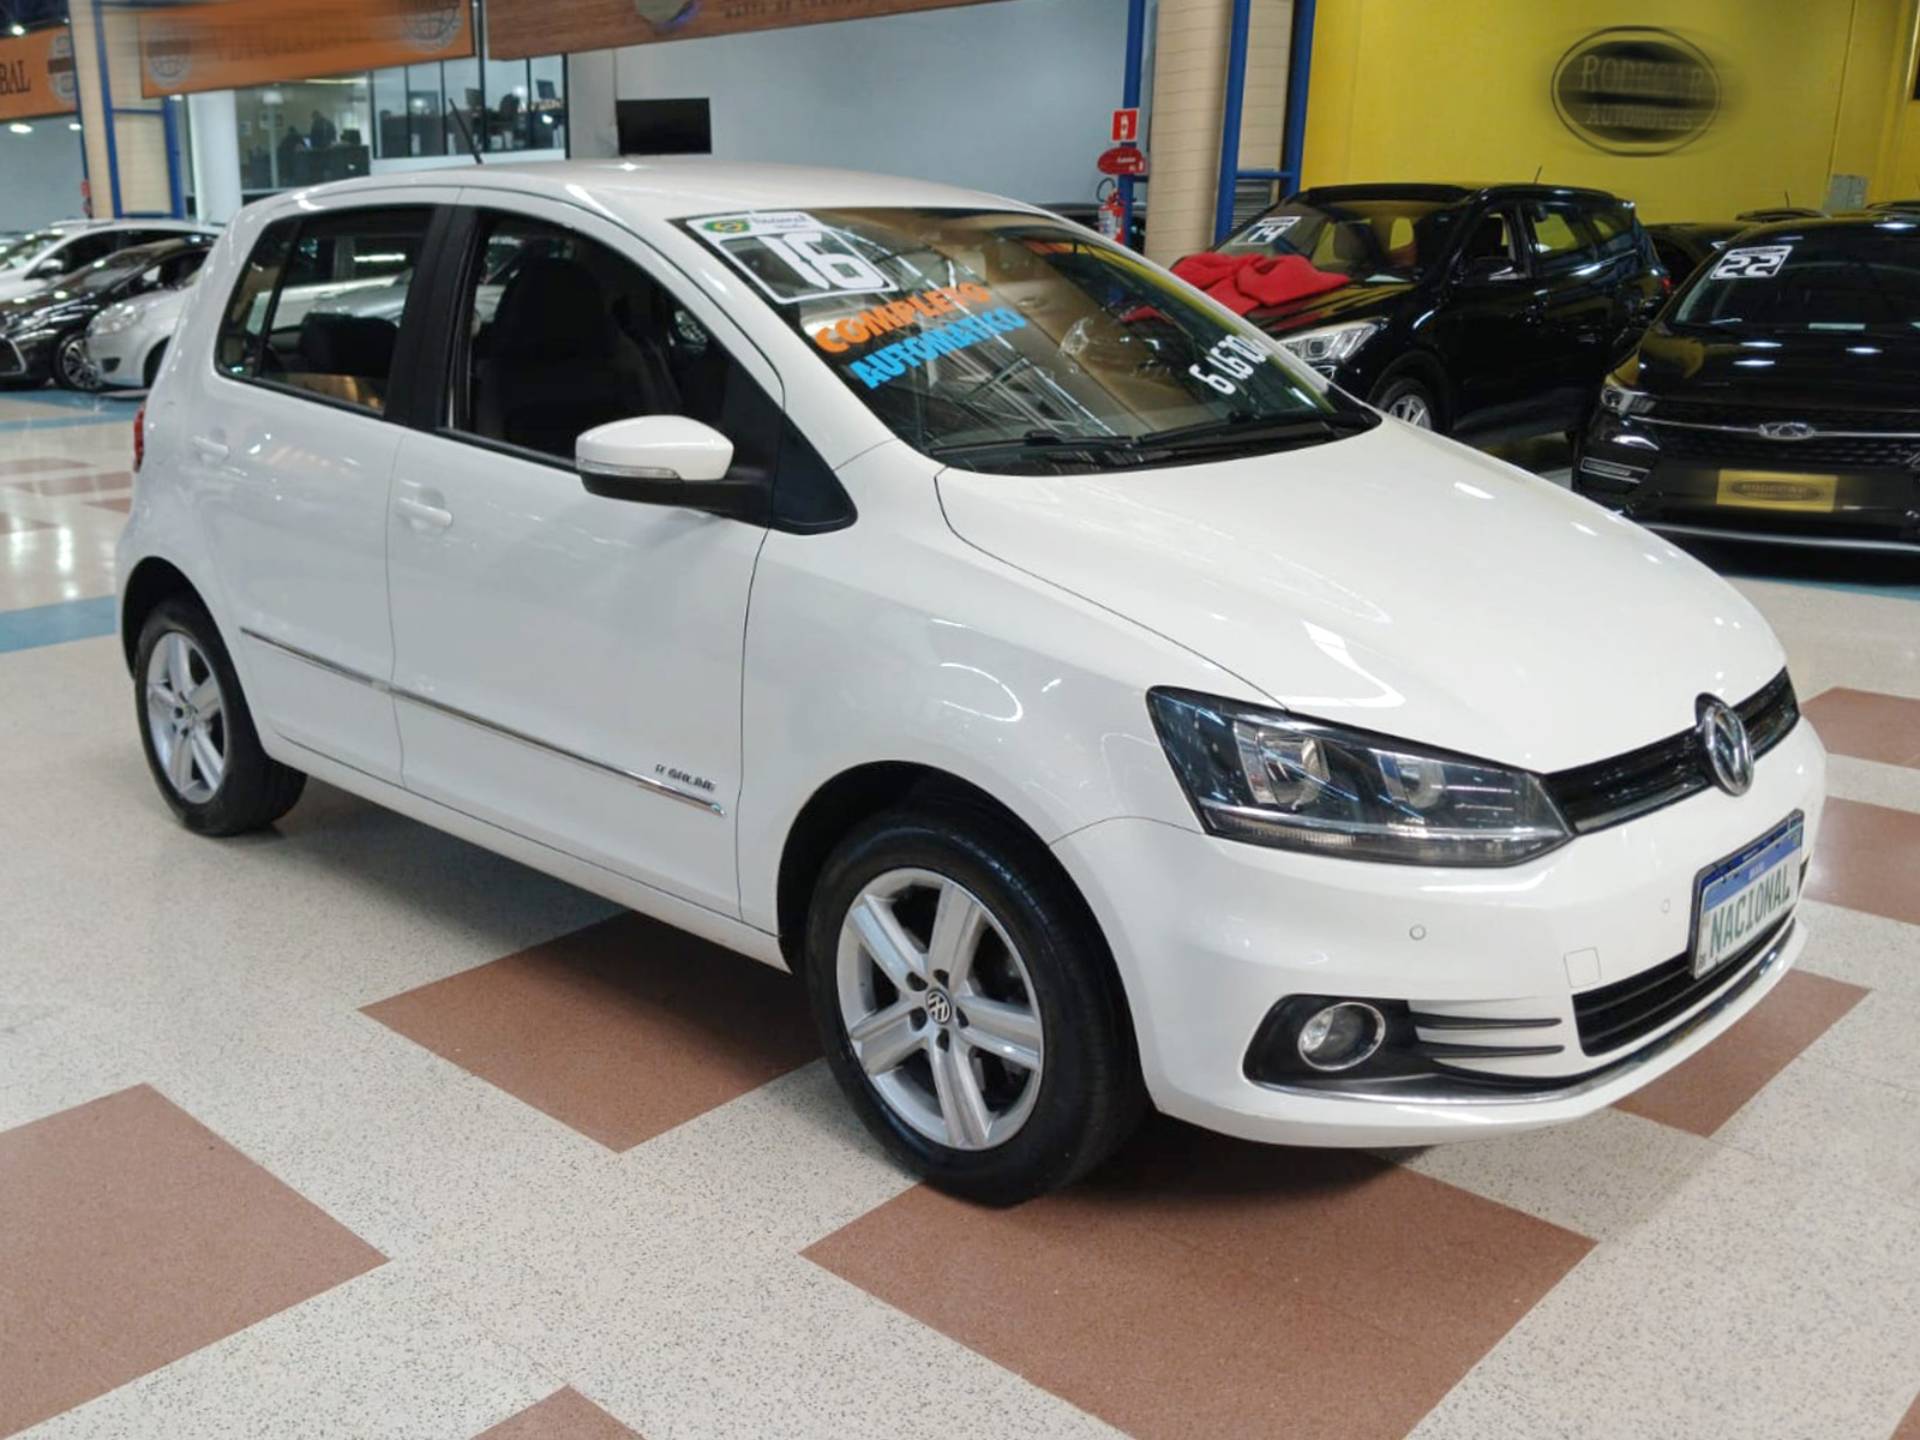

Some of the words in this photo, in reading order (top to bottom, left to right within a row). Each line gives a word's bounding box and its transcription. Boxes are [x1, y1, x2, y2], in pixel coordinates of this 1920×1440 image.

[757, 232, 884, 289] 16
[1716, 256, 1780, 276] 22
[815, 282, 991, 353] COMPLETO
[1710, 864, 1790, 958] NACIONAL
